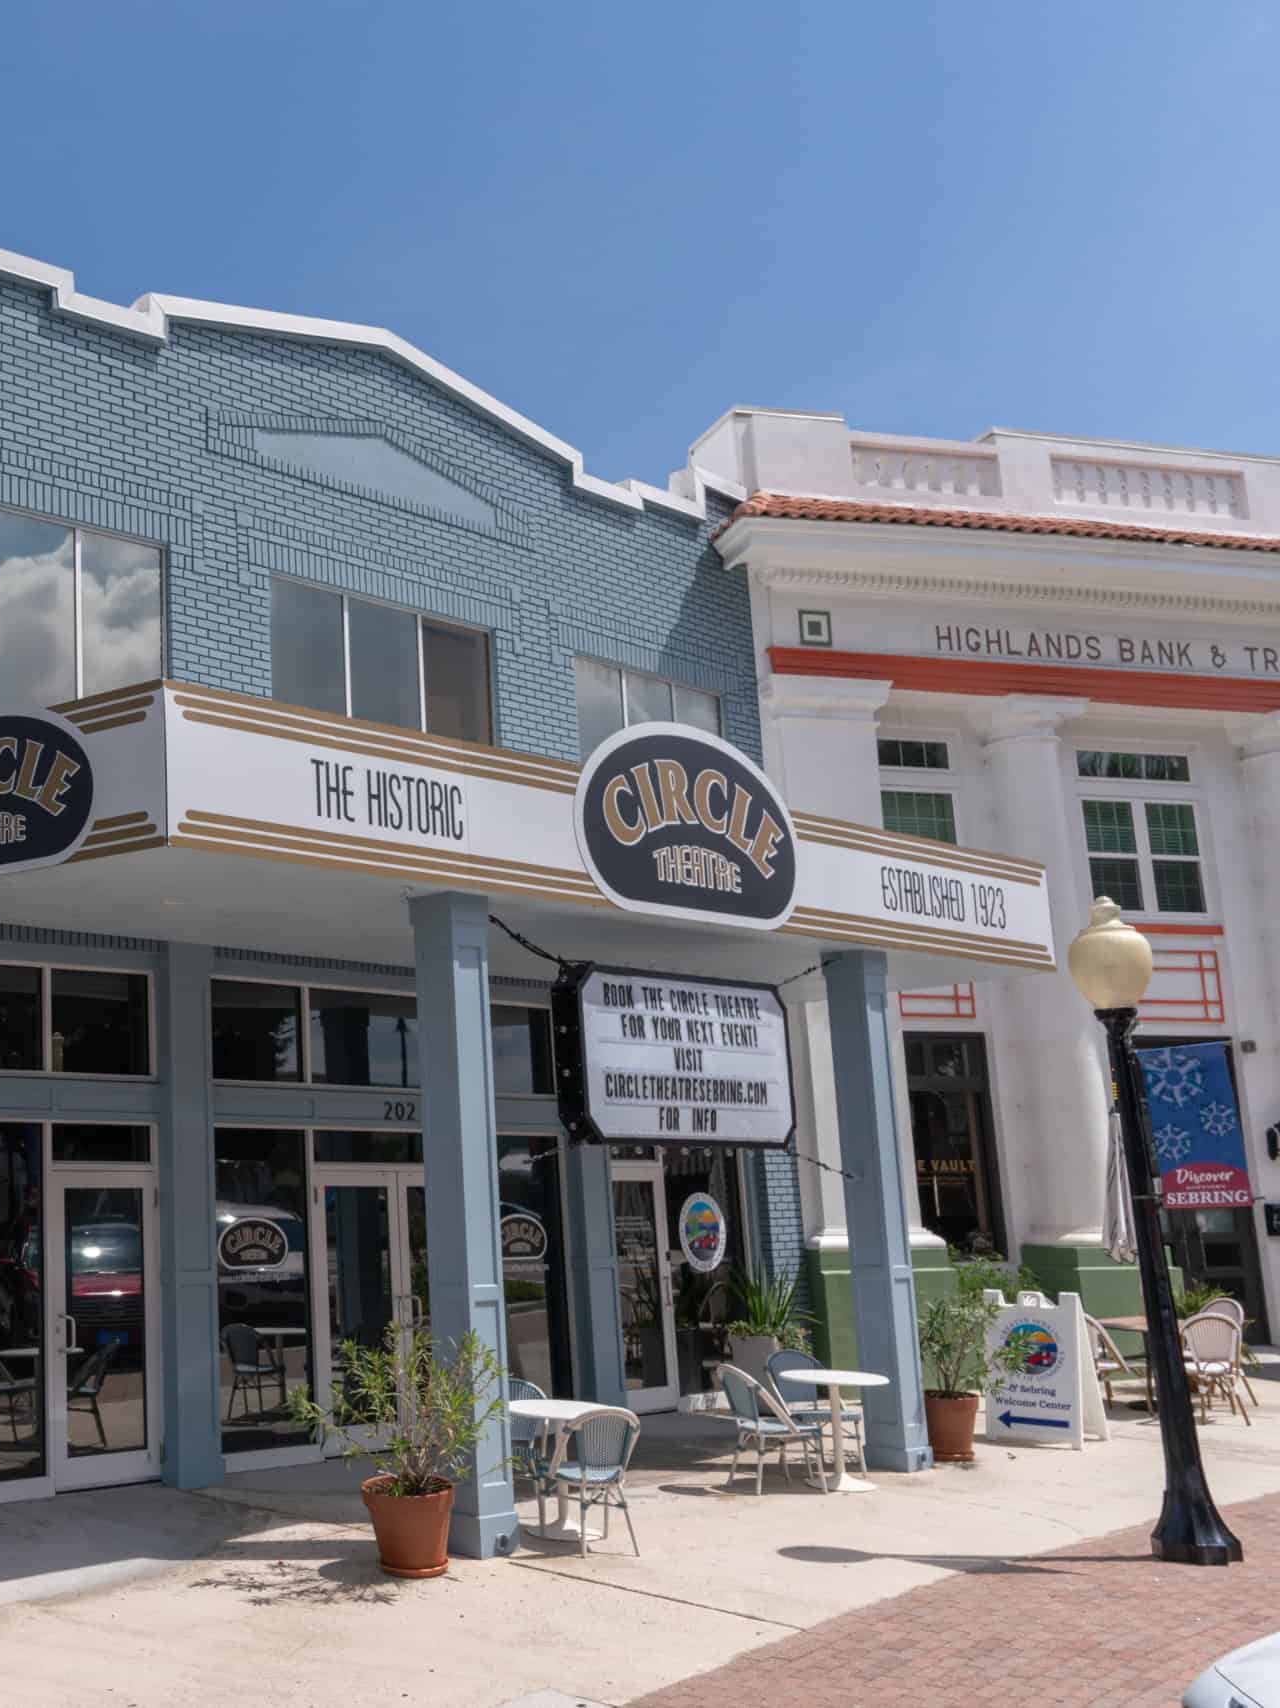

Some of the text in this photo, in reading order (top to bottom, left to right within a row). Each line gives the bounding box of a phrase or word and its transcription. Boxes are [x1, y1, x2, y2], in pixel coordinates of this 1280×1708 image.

[935, 625, 1101, 661] HIGHLANDS
[1119, 638, 1194, 667] BANK
[1210, 644, 1227, 669] &
[310, 758, 464, 841] THE HISTORIC
[602, 759, 785, 880] CIRCLE
[652, 844, 743, 894] THEATRE
[880, 865, 1007, 930] ESTABLISHED 1923
[603, 982, 761, 1021] BOOK THE CIRCLE THEATRE
[621, 1014, 759, 1049] FOR YOUR NEXT EVENT!
[673, 1048, 704, 1073] VISIT
[605, 1073, 768, 1106] CIRCLETHEATRESEBRING.COM
[384, 1101, 417, 1121] 202
[659, 1106, 718, 1133] FOR INFO
[930, 1160, 976, 1174] VAULT
[1175, 1168, 1235, 1185] Discover
[1167, 1189, 1249, 1205] SEBRING
[996, 1396, 1072, 1411] Welcome Center
[1020, 1384, 1057, 1397] Sebring
